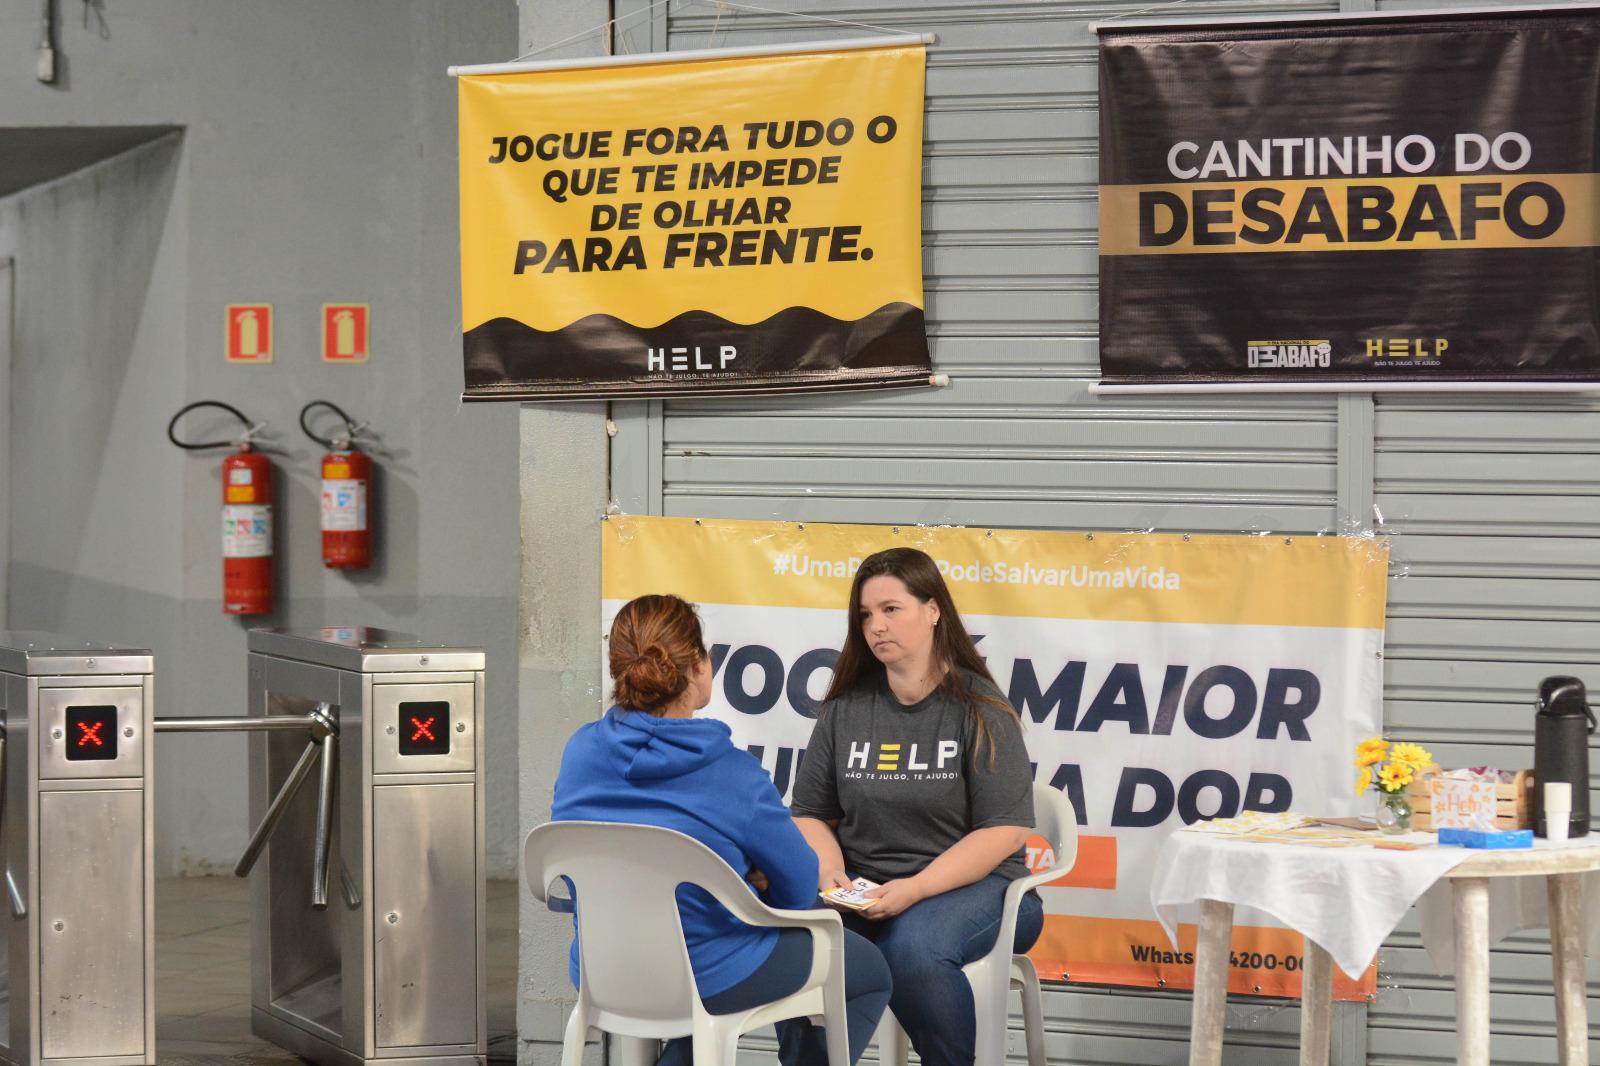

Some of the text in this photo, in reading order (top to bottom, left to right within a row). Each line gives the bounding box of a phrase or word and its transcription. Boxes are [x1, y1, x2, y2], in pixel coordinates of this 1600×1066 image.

[488, 115, 897, 164] JOGUE FORA TUDO O
[1167, 131, 1532, 180] CANTINHO DO
[542, 155, 842, 202] QUE TE IMPEDE
[590, 196, 792, 232] DE OLHAR
[1138, 181, 1566, 247] DESABAFO
[513, 225, 874, 275] PARA FRENTE.
[648, 345, 737, 371] HELP
[1247, 345, 1331, 368] DESABAFO
[1366, 338, 1449, 357] HELP
[1007, 658, 1321, 742] MAIOR
[845, 771, 862, 779] NÃO
[879, 773, 909, 781] JULGO,
[847, 740, 958, 771] HELP
